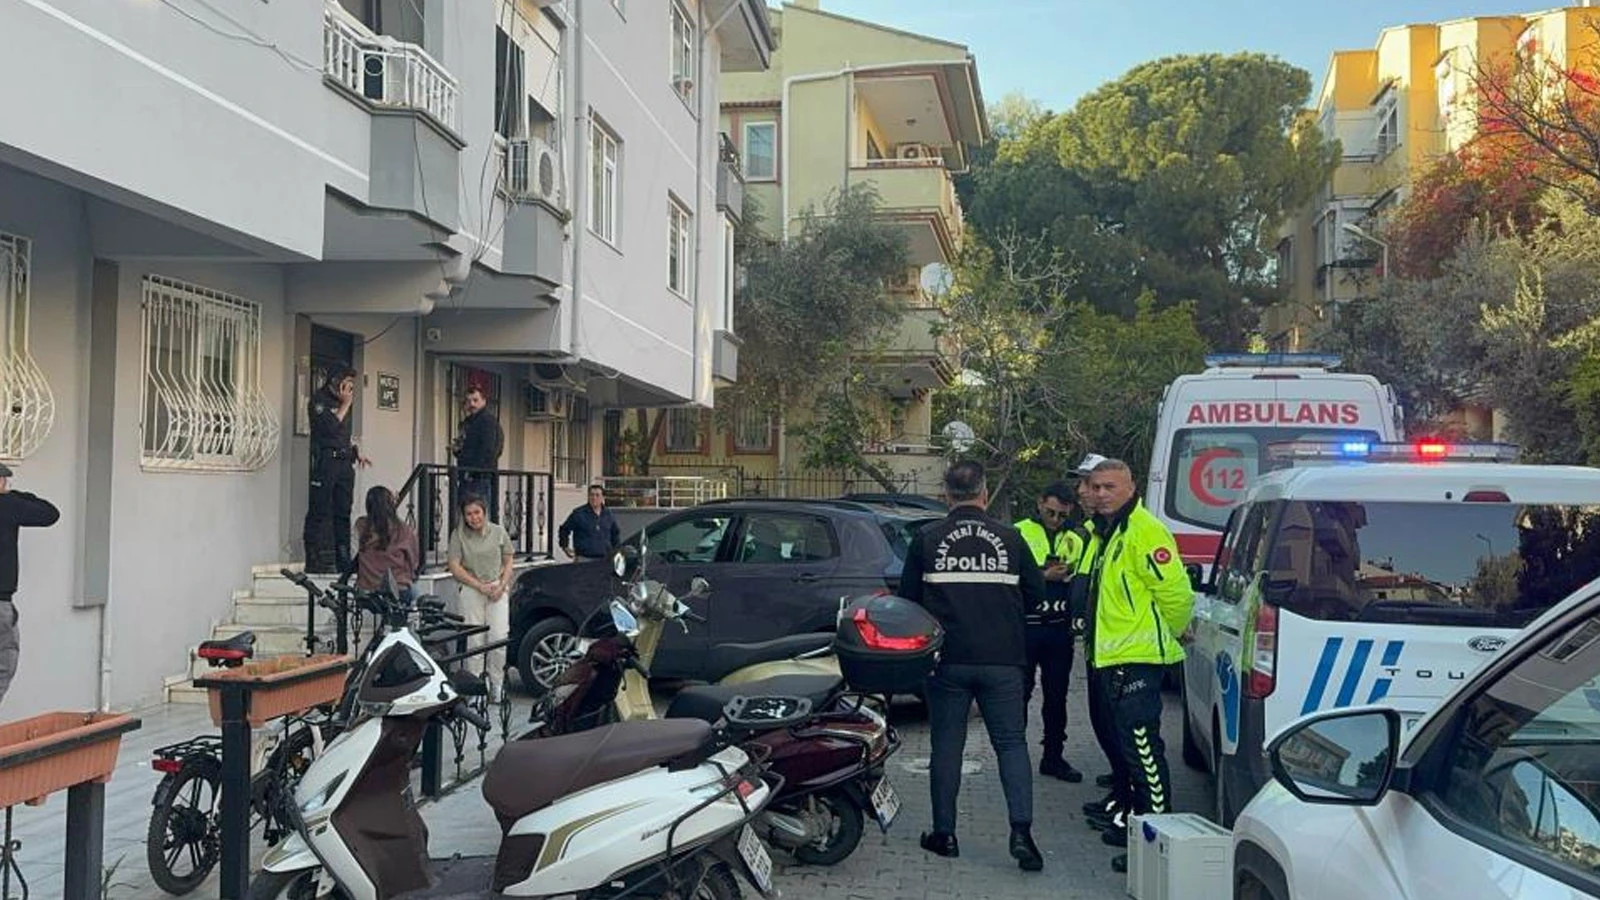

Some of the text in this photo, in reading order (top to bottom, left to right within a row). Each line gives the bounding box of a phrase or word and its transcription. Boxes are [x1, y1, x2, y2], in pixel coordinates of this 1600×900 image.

[1186, 403, 1360, 424] AMBULANS
[1203, 468, 1244, 489] 112
[934, 541, 951, 571] OLAY
[946, 553, 997, 571] POLİS
[1385, 668, 1465, 680] TOU
